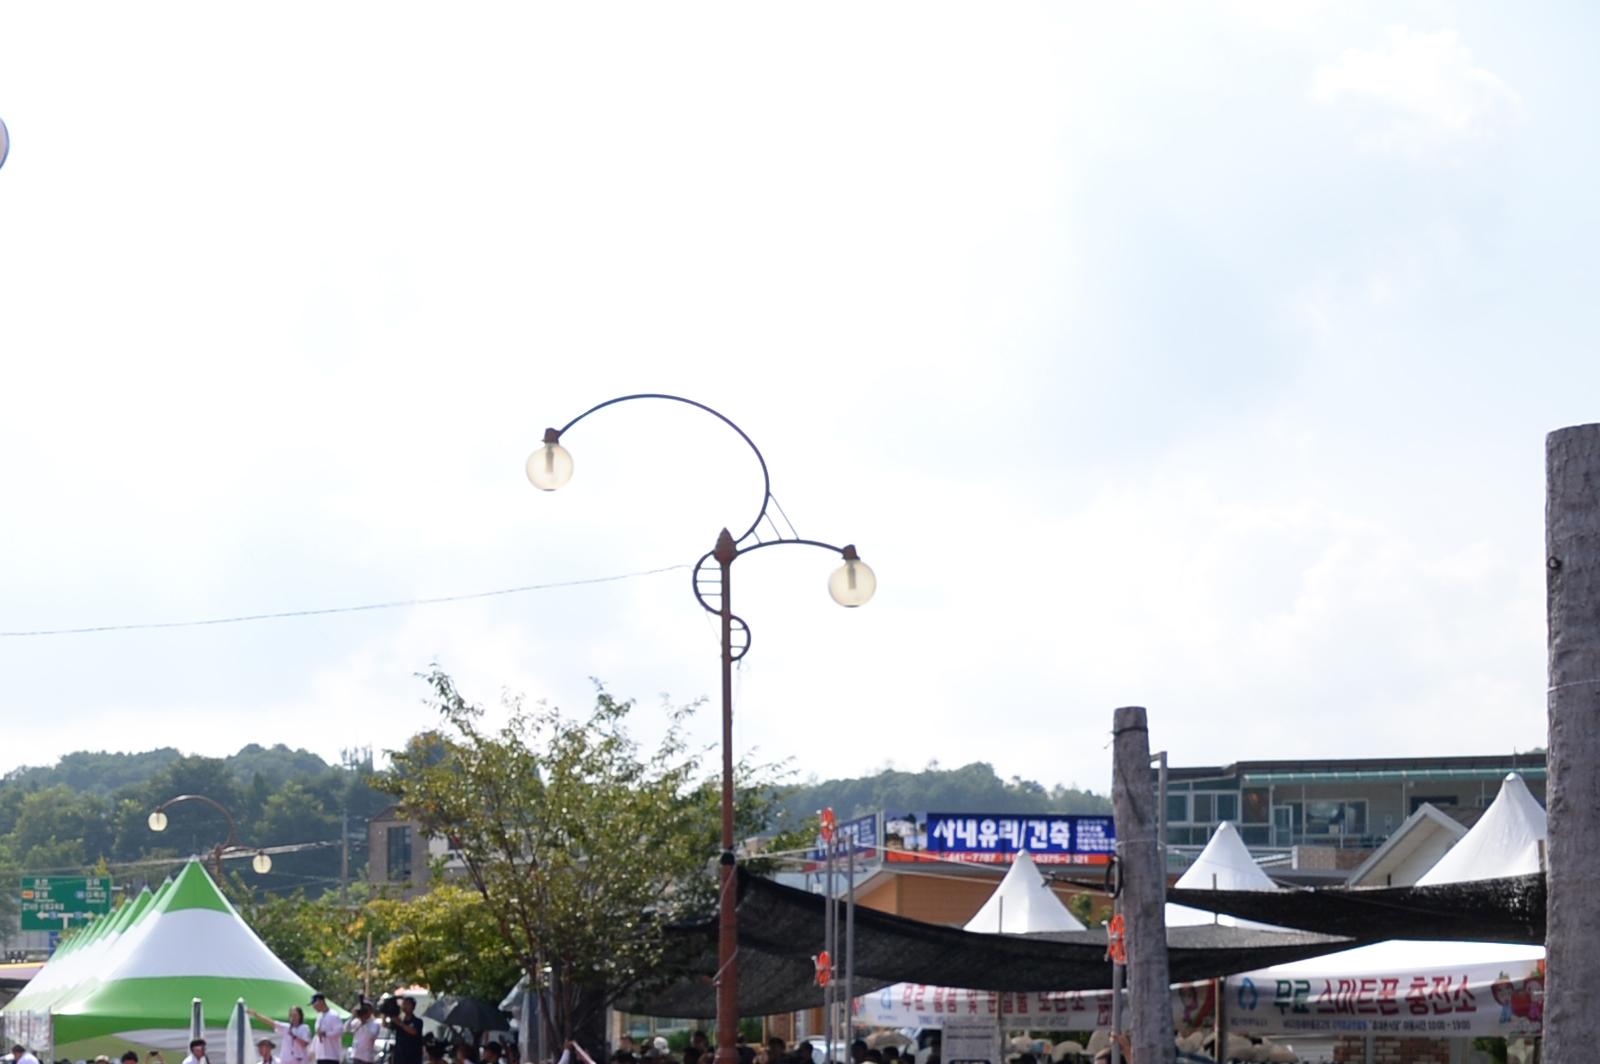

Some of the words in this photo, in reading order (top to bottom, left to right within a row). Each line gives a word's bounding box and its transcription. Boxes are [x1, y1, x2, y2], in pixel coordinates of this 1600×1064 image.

[933, 819, 1070, 850] 사내유리/건축
[1274, 979, 1311, 1014] 무료
[1317, 977, 1399, 1015] 스마트폰
[1405, 975, 1477, 1015] 충전소
